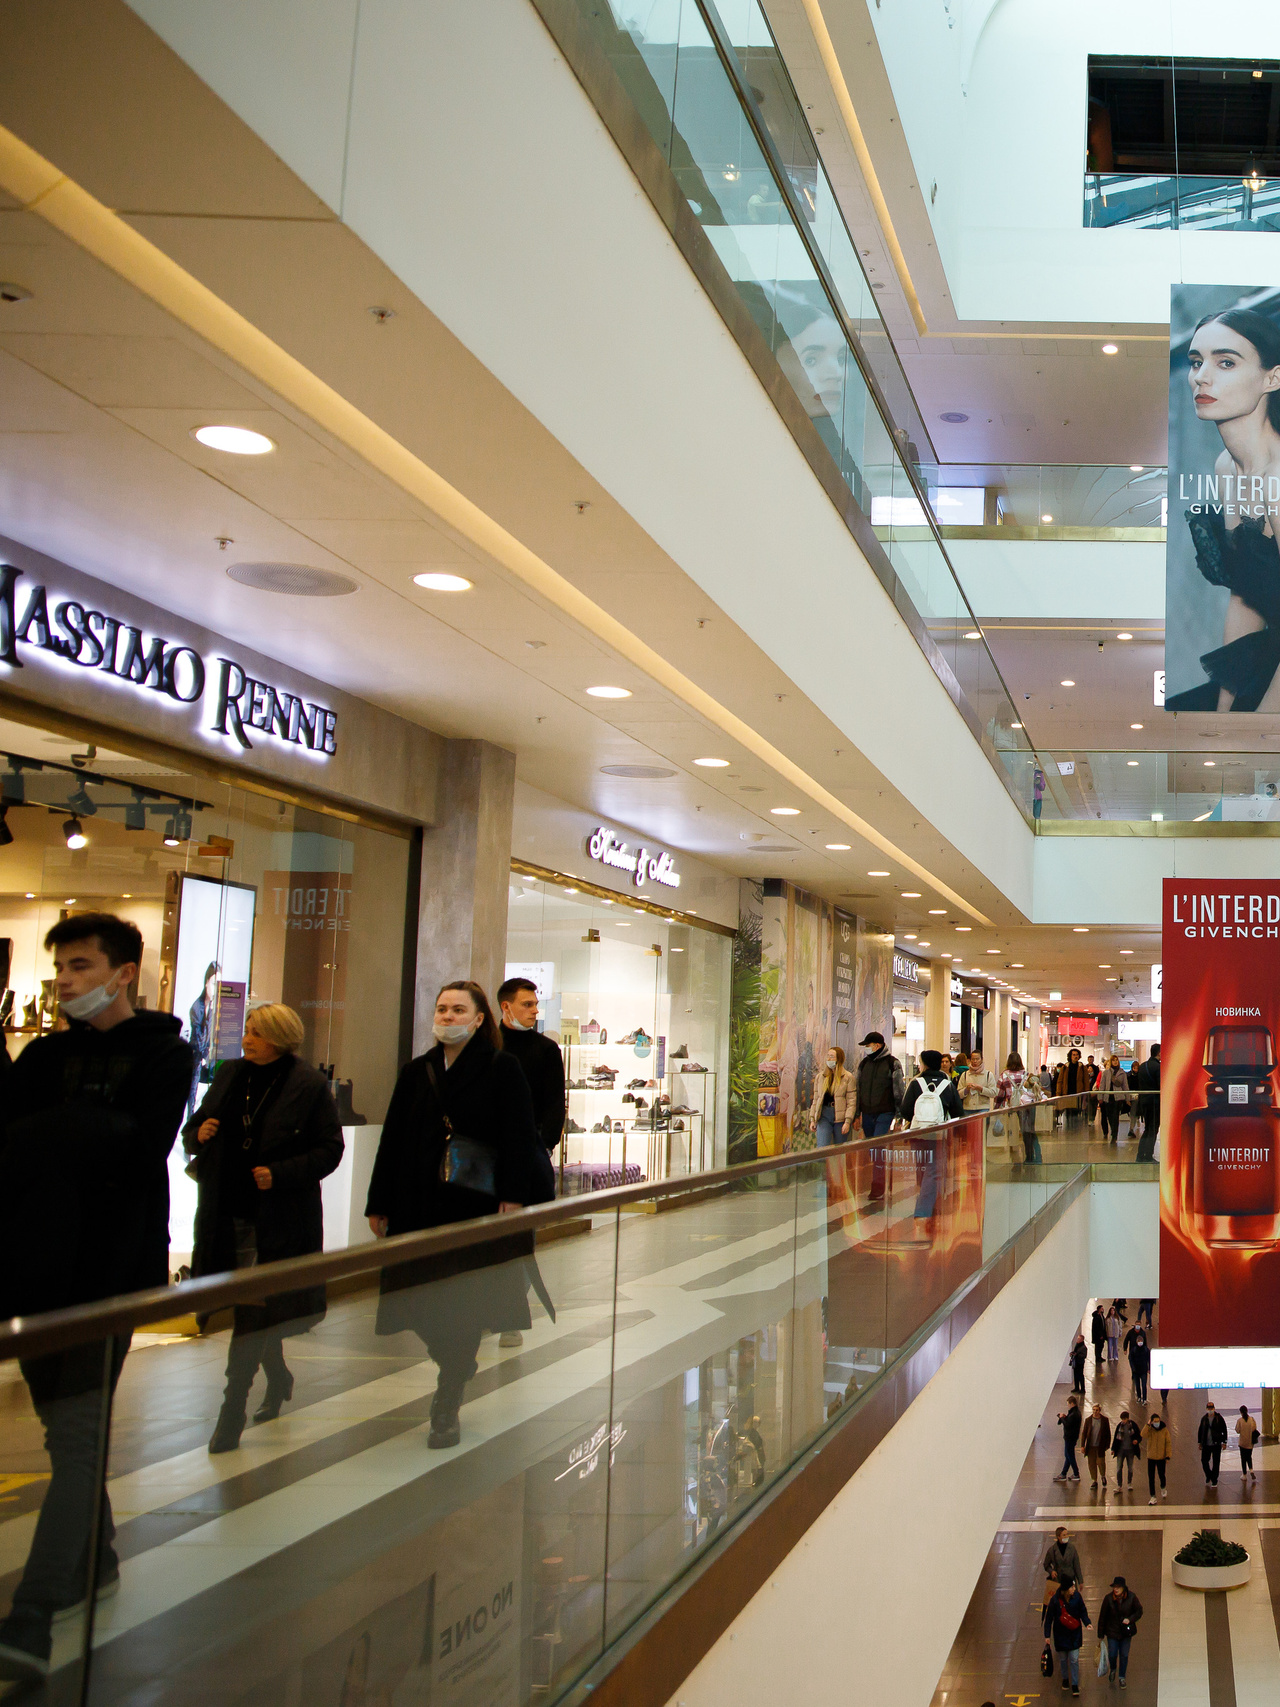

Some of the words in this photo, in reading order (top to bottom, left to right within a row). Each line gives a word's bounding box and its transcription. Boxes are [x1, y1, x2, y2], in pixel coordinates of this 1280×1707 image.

[1215, 1007, 1262, 1017] НОВИНКА
[1208, 1147, 1270, 1163] L'INTERDIT
[1158, 1363, 1164, 1377] 1
